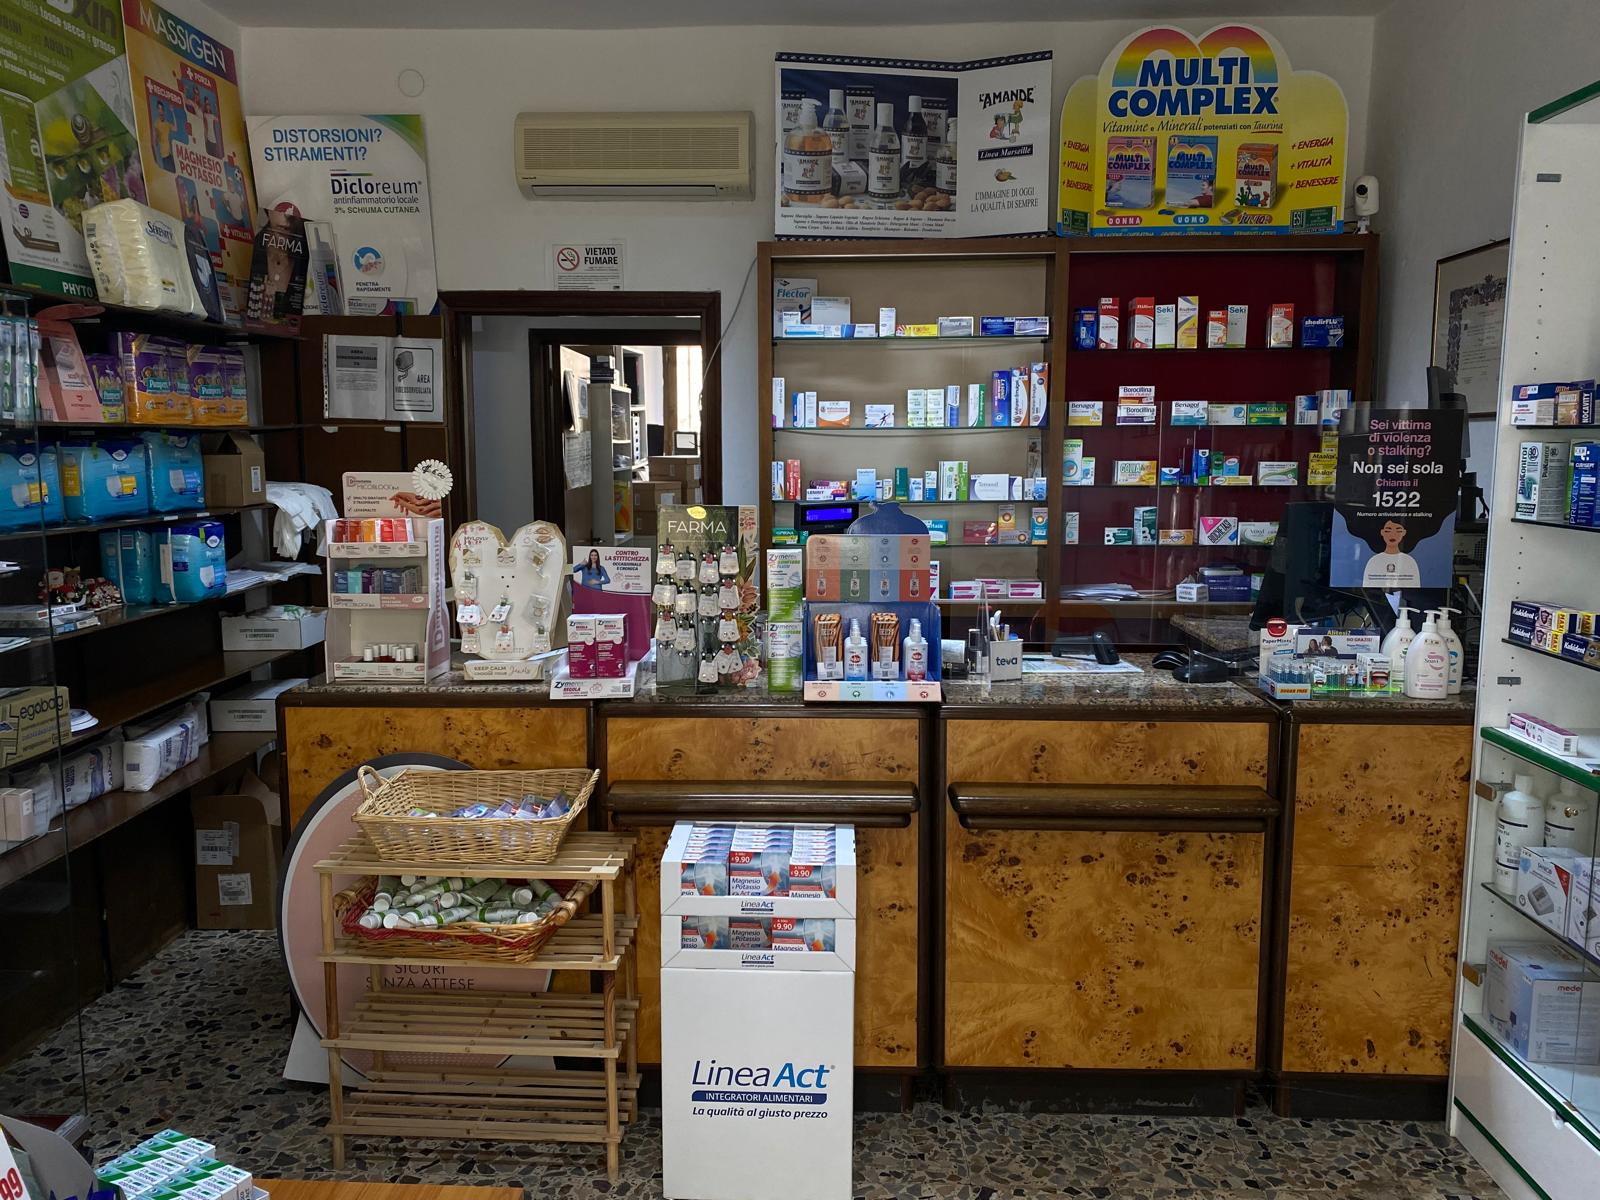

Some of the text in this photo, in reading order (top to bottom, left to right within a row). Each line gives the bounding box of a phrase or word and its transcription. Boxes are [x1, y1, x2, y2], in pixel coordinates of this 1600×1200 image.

[140, 5, 227, 73] MASSIGEN
[1139, 57, 1250, 88] MULTI
[979, 88, 1034, 110] L'AMANDE
[1108, 87, 1278, 117] COMPLEX
[1103, 121, 1148, 132] Vitamine
[1158, 118, 1202, 132] Minerali
[1253, 120, 1284, 130] Taurina
[273, 128, 382, 144] DISTORSIONI?
[1298, 138, 1334, 150] ENERGIA
[264, 146, 367, 162] STIRAMENTI?
[980, 146, 1032, 158] Linea Marseille
[1116, 154, 1143, 162] MULTI
[1176, 152, 1206, 161] MULTI
[176, 144, 222, 174] MAGNESIO
[1168, 160, 1213, 169] COMPLEX
[1297, 156, 1332, 169] VITALITÀ
[1108, 162, 1150, 170] COMPLEX
[180, 160, 222, 188] POTASSIO
[331, 178, 418, 194] Dicloreum
[1296, 176, 1339, 188] BENESSERE
[333, 196, 418, 204] antinfiammatorio locale
[976, 187, 1034, 200] L'IMMAGINE DI OGGI
[971, 198, 1038, 212] LA QUALITÀ DI SEMPRE
[262, 234, 302, 254] FARMA
[585, 248, 616, 256] VIETATO
[584, 256, 618, 264] FUMARE
[62, 281, 94, 298] PHYTO
[776, 288, 808, 298] Flector
[417, 374, 430, 383] AREA
[1370, 419, 1432, 430] Sei vittima
[1369, 432, 1431, 443] di violenza
[1368, 445, 1432, 458] o stalking?
[1353, 462, 1444, 474] Non sei sola
[1518, 446, 1528, 494] PlaKontrol
[1376, 478, 1418, 487] Chiama il
[1372, 492, 1421, 508] 1522
[1570, 474, 1580, 524] PREVENT
[668, 520, 727, 534] FARMA
[996, 656, 1018, 666] teva
[1489, 949, 1508, 970] medel
[395, 965, 445, 974] SICURI
[422, 977, 474, 990] ATTESE
[706, 1092, 812, 1102] INTEGRATORI ALIMENTARI
[692, 1106, 828, 1120] La qualità al giusto prezzo
